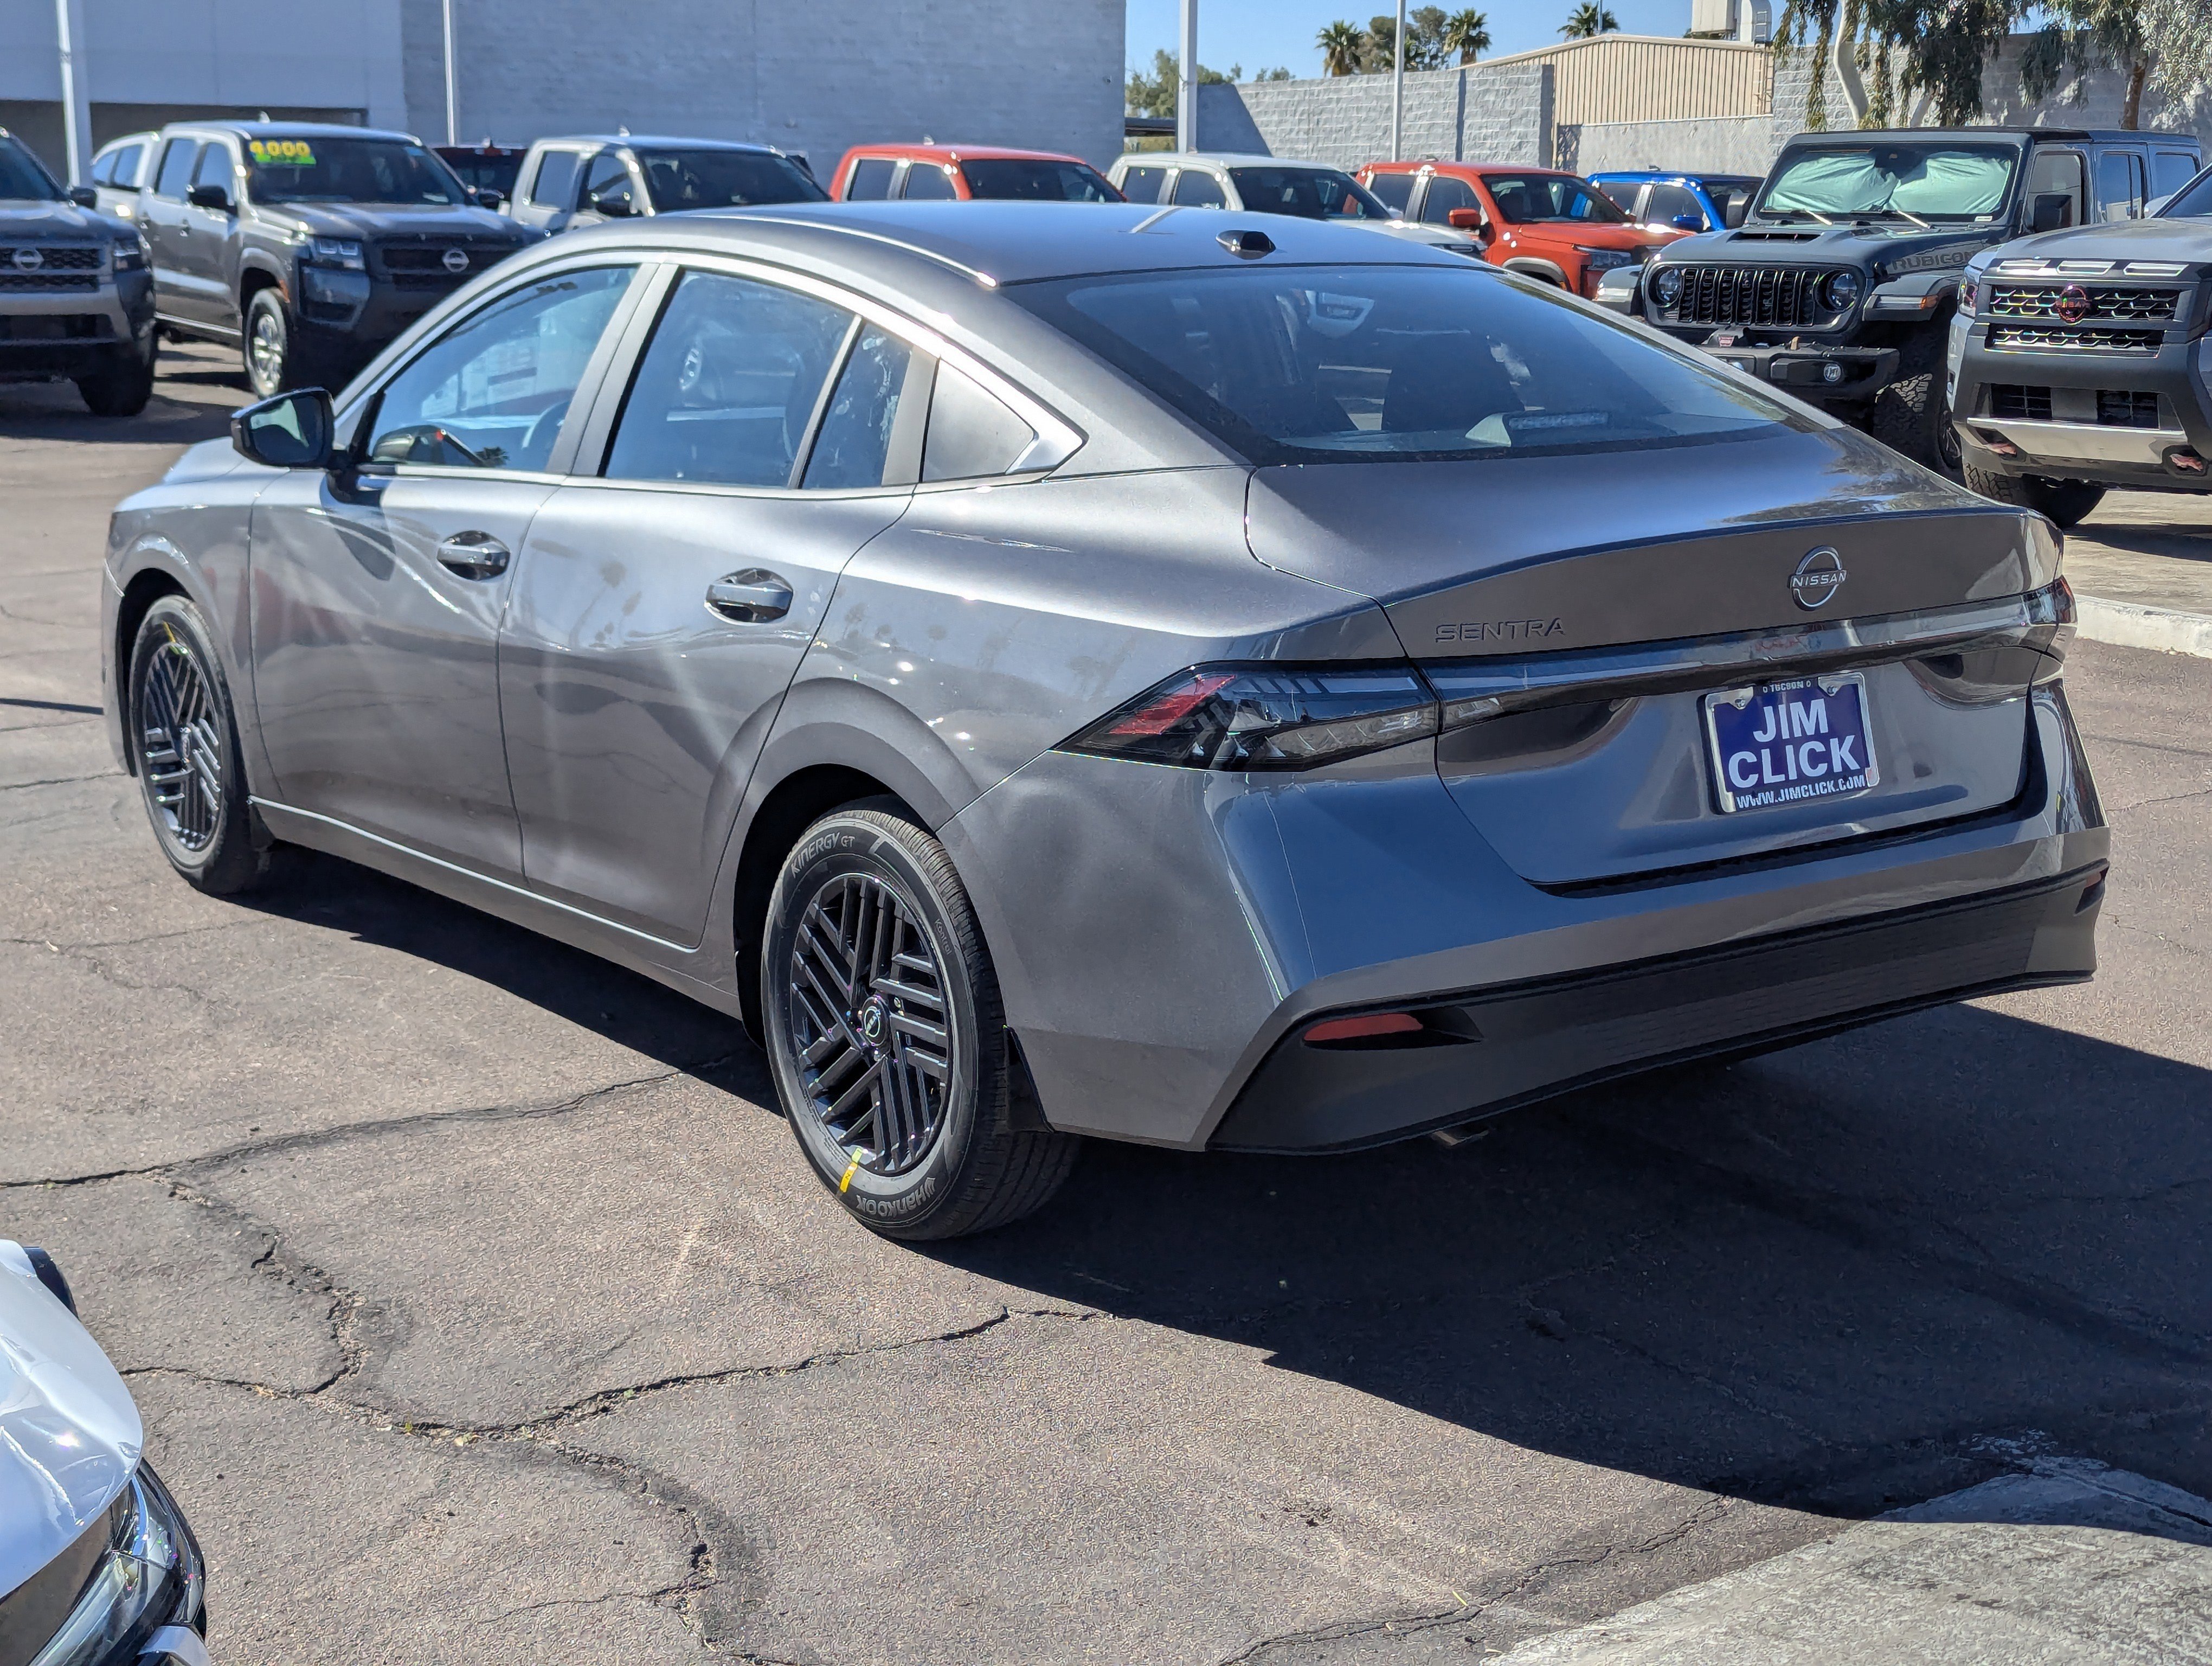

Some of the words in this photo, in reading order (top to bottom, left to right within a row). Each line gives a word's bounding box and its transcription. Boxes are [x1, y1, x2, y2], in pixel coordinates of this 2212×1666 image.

[1792, 570, 1846, 587] NISSAN
[1436, 617, 1566, 643] SENTRA
[1769, 681, 1804, 693] TUCSON
[1753, 698, 1829, 742] JIM
[1728, 735, 1861, 789] CLICK
[1736, 775, 1866, 809] WWW.JIMCLICK.COM
[790, 832, 840, 879] KINERGY
[841, 835, 856, 848] GT
